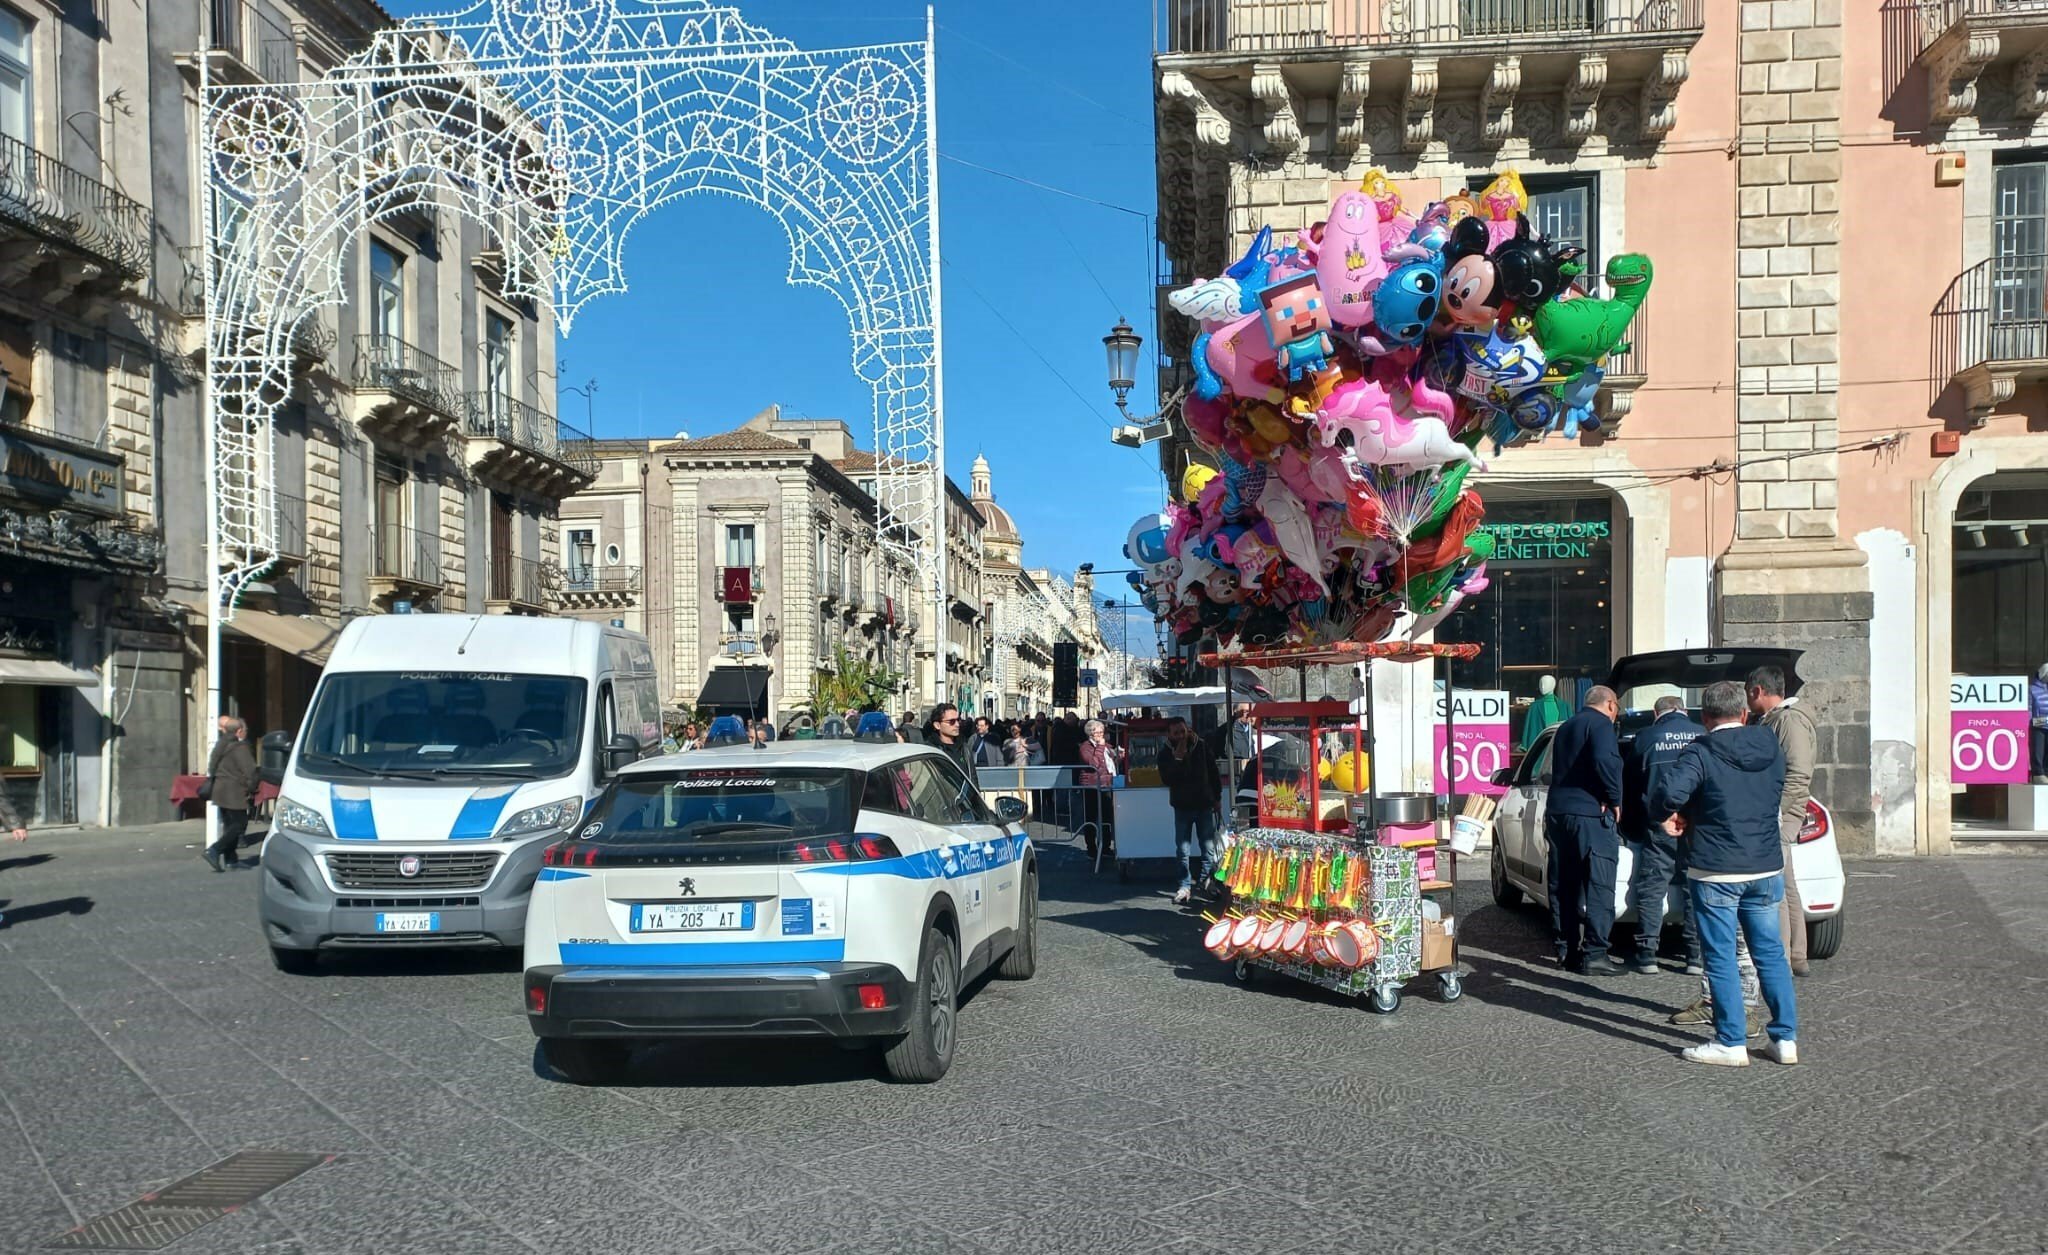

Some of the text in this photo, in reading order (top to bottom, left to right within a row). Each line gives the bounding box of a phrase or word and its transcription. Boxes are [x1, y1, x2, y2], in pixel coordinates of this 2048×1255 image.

[1333, 288, 1372, 304] BARBAPA
[1465, 375, 1486, 395] FAST
[1477, 522, 1609, 538] ITED COLORS
[732, 577, 743, 592] A
[400, 671, 512, 681] POLIZIA LOCALE
[1951, 683, 2022, 703] SALDI
[1436, 698, 1504, 717] SALDI
[1665, 731, 1697, 740] Polizi
[1655, 741, 1690, 751] Munic
[673, 778, 776, 788] Polizia Locale
[958, 848, 981, 872] Polizia
[692, 904, 719, 912] LOCALE
[385, 920, 396, 930] YA
[401, 920, 417, 930] 417
[419, 920, 429, 929] AF
[649, 914, 663, 928] YA
[680, 913, 703, 927] 203
[719, 912, 735, 926] AT
